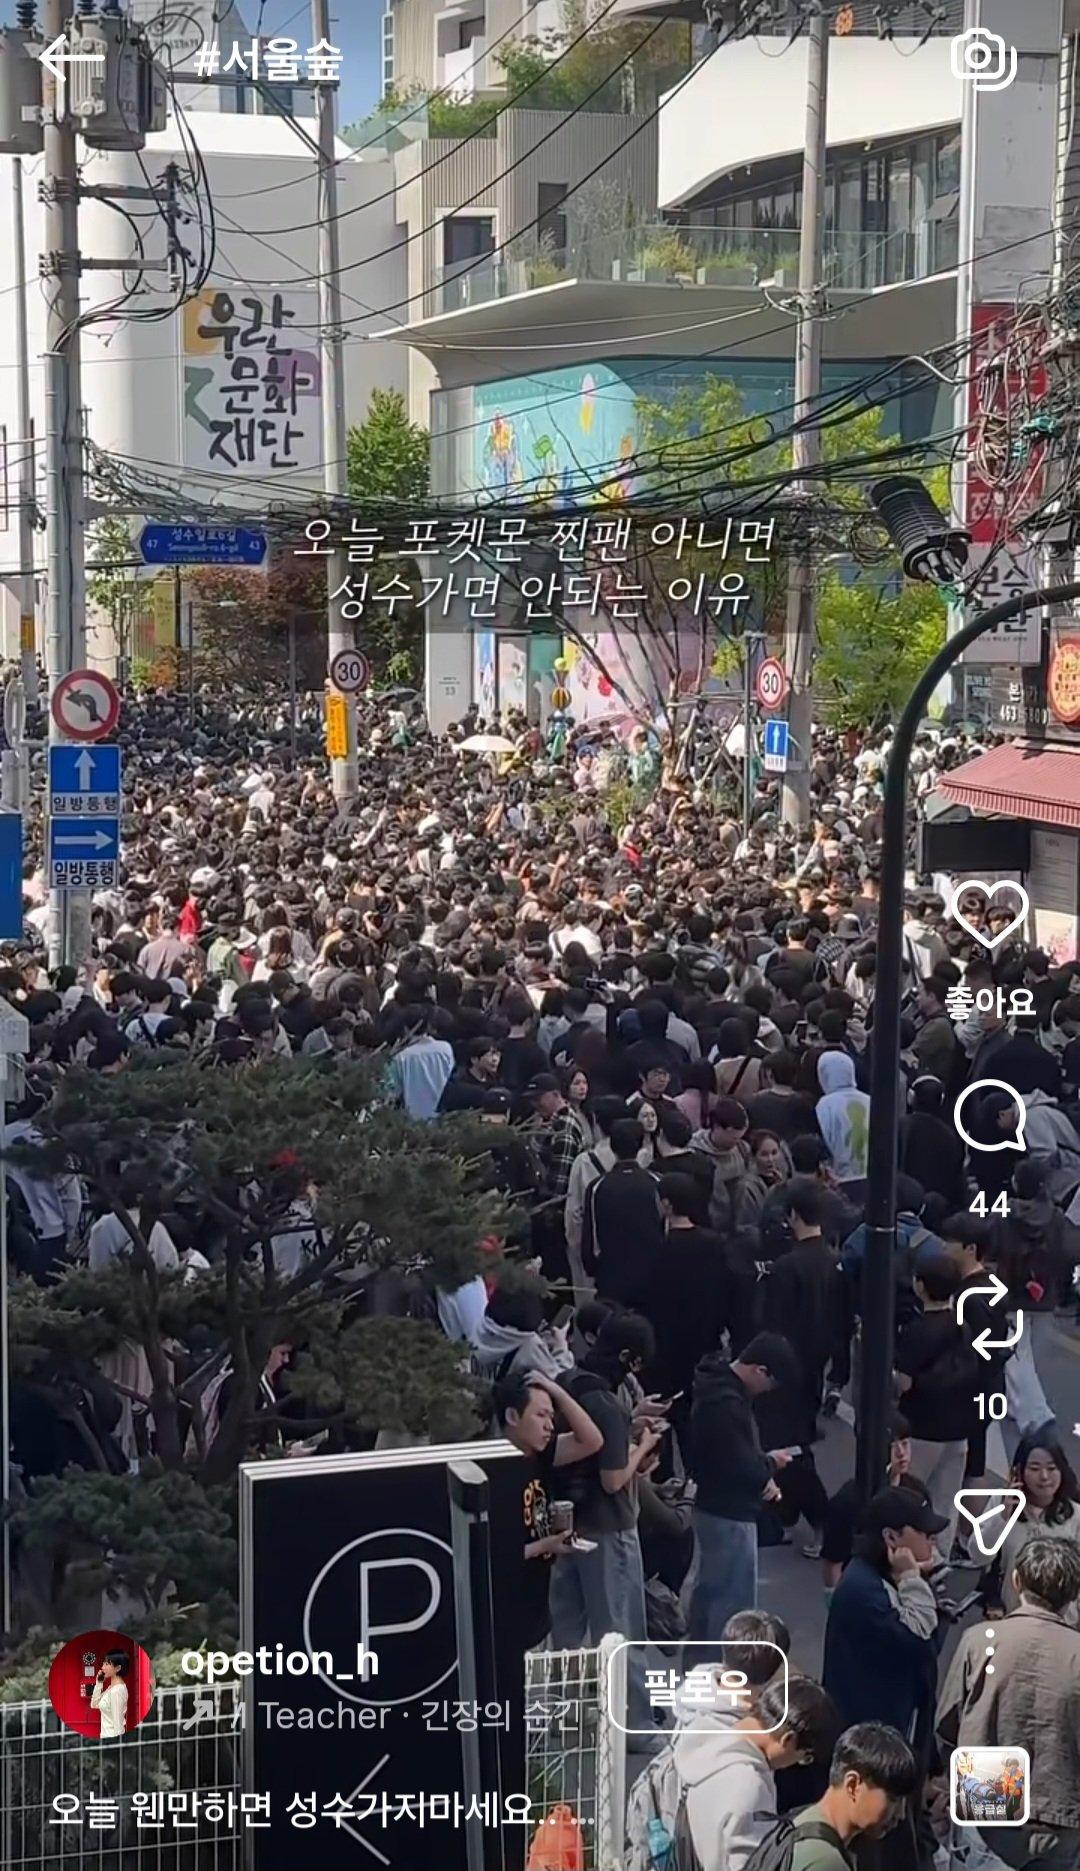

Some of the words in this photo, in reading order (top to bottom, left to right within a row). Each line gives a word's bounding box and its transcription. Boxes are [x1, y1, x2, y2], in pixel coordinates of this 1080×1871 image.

[197, 292, 296, 360] 우란
[219, 356, 311, 416] 문화
[208, 417, 305, 468] 재단
[338, 661, 361, 682] 30
[763, 672, 779, 694] 30
[53, 796, 117, 812] 일방통행
[54, 860, 114, 886] 일방통행
[360, 1557, 441, 1683] P
